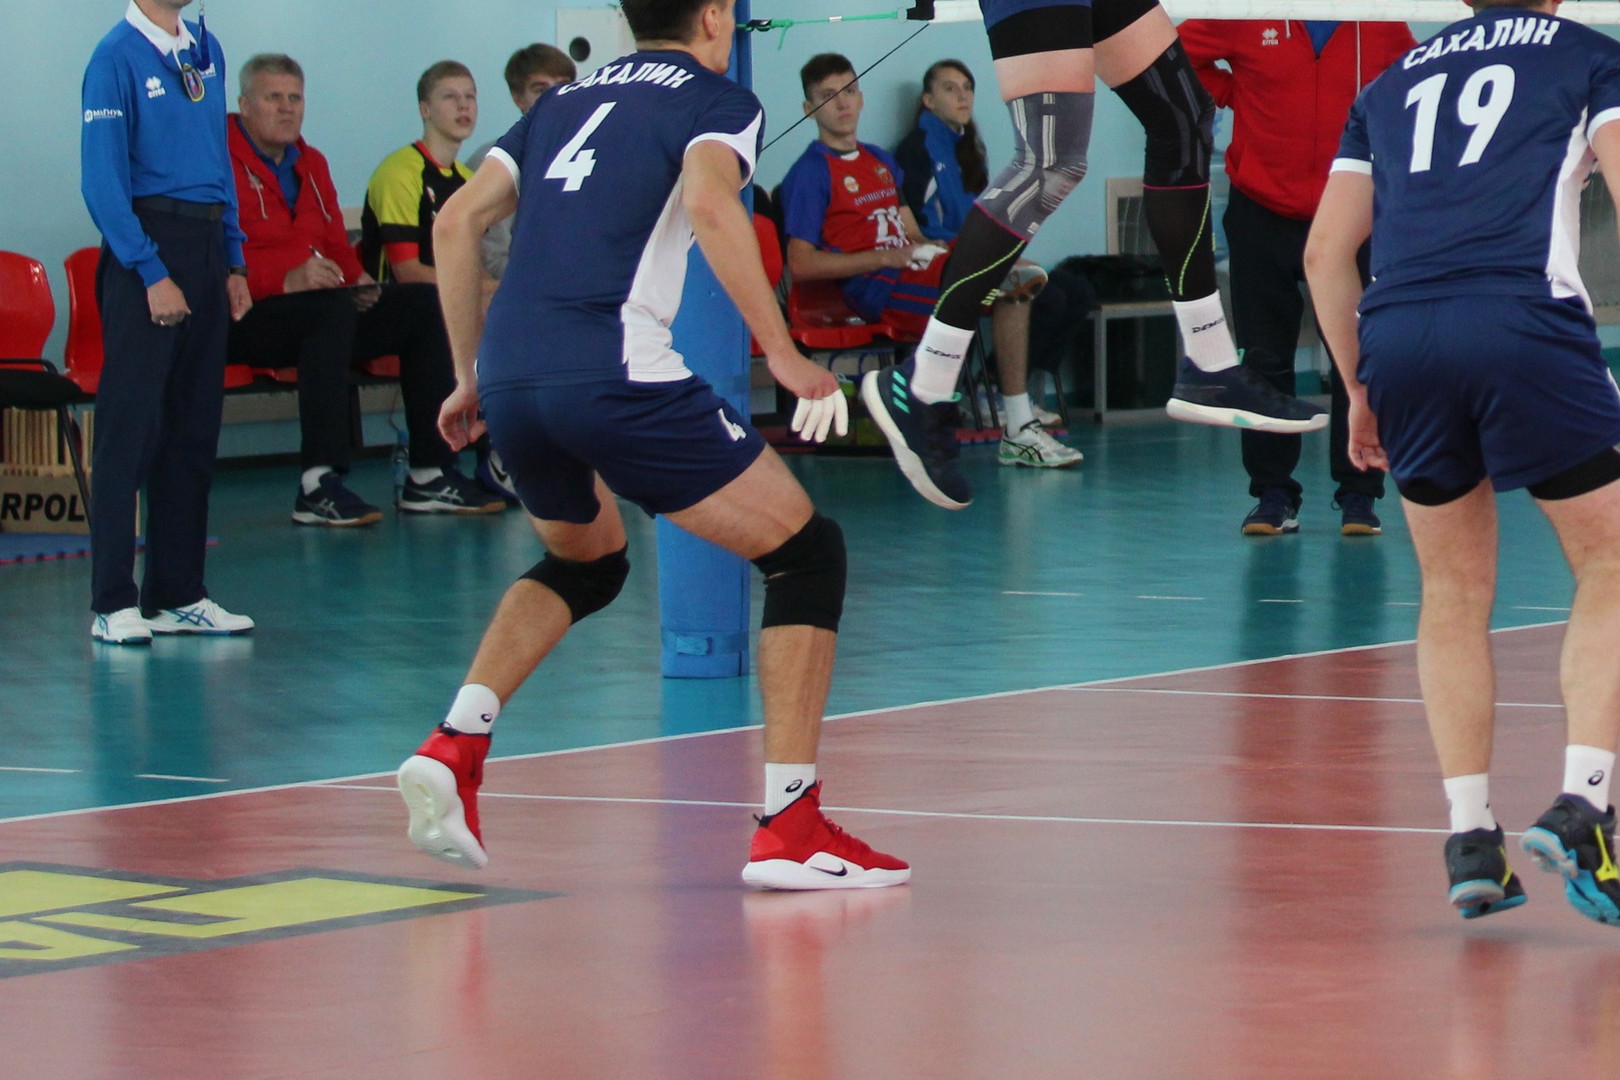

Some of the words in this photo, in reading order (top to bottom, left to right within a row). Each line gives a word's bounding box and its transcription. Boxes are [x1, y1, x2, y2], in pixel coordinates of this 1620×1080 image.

[1403, 17, 1560, 69] САХАЛИН
[556, 62, 696, 96] САХАЛИН
[1405, 64, 1516, 174] 19
[544, 101, 597, 192] 4
[718, 407, 747, 441] 4
[1, 492, 85, 522] RPOL
